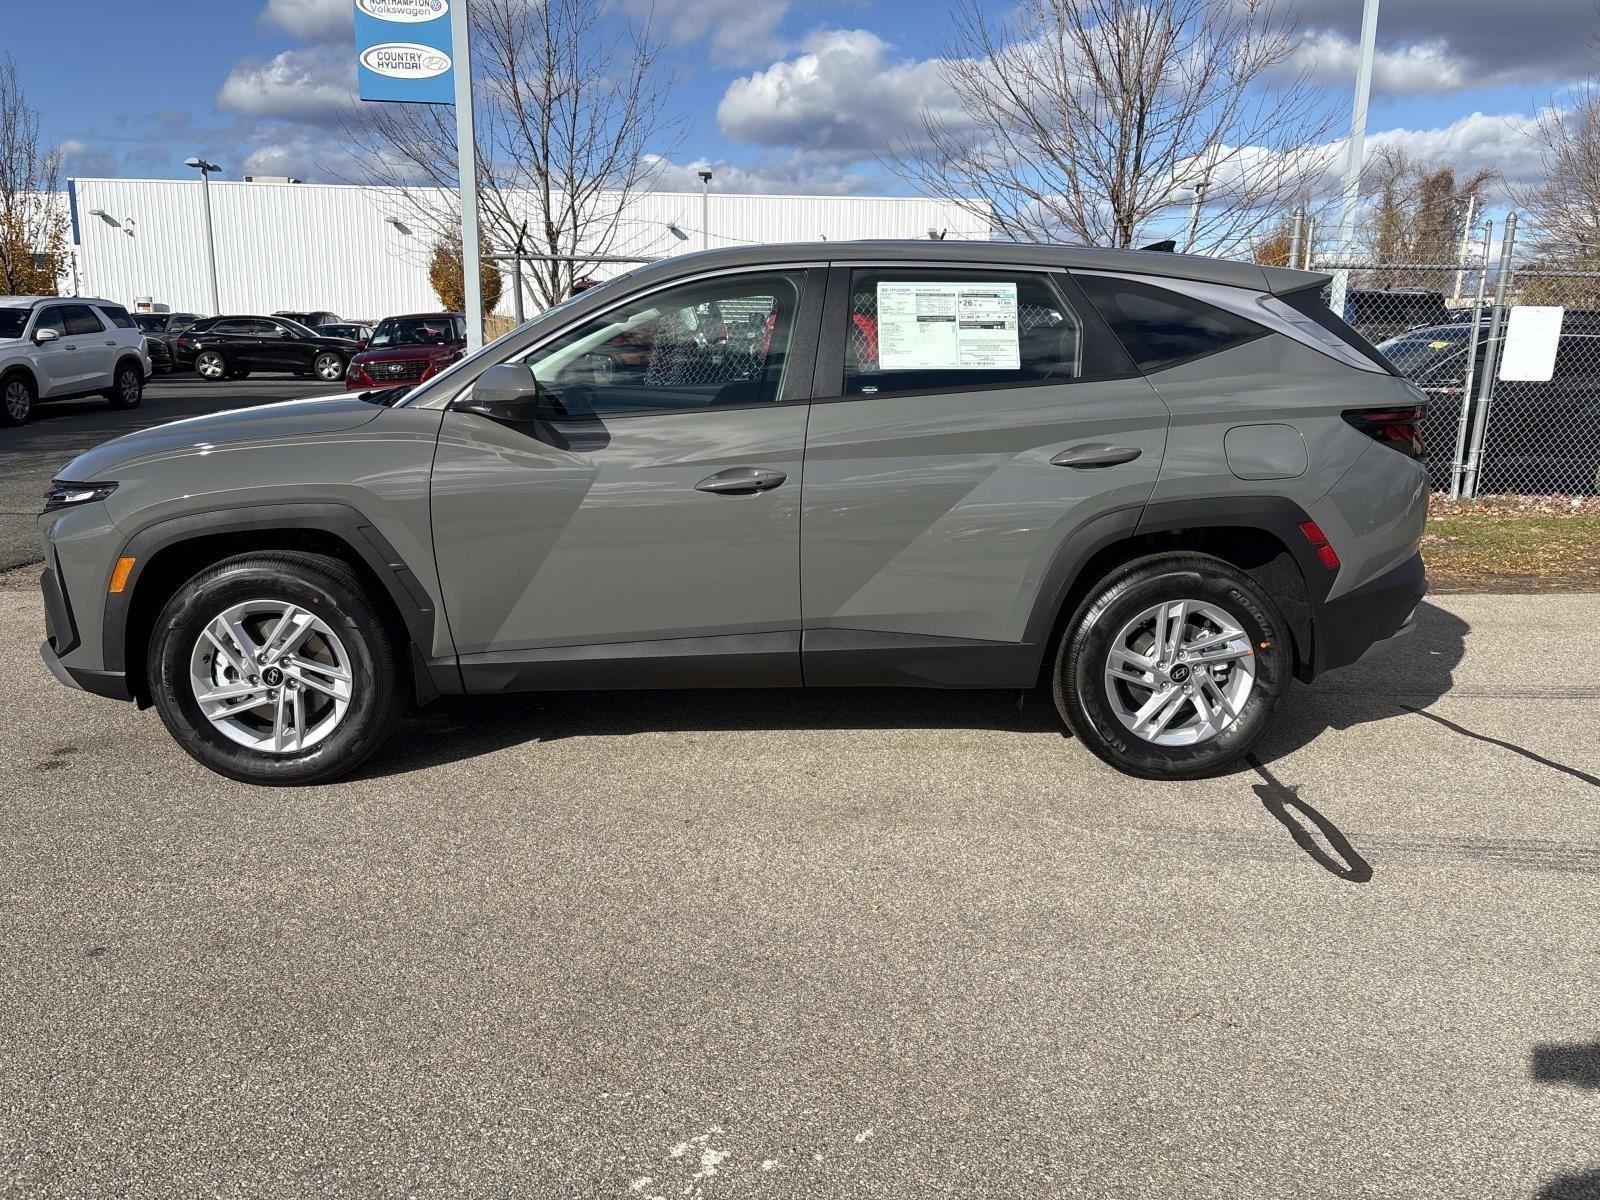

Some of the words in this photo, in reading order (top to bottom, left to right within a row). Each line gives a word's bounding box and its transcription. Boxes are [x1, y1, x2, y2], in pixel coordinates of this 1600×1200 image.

[370, 4, 431, 16] Volkswagen
[377, 51, 422, 62] COUNTRY
[377, 61, 421, 70] HYUNDAI
[963, 299, 973, 307] 26
